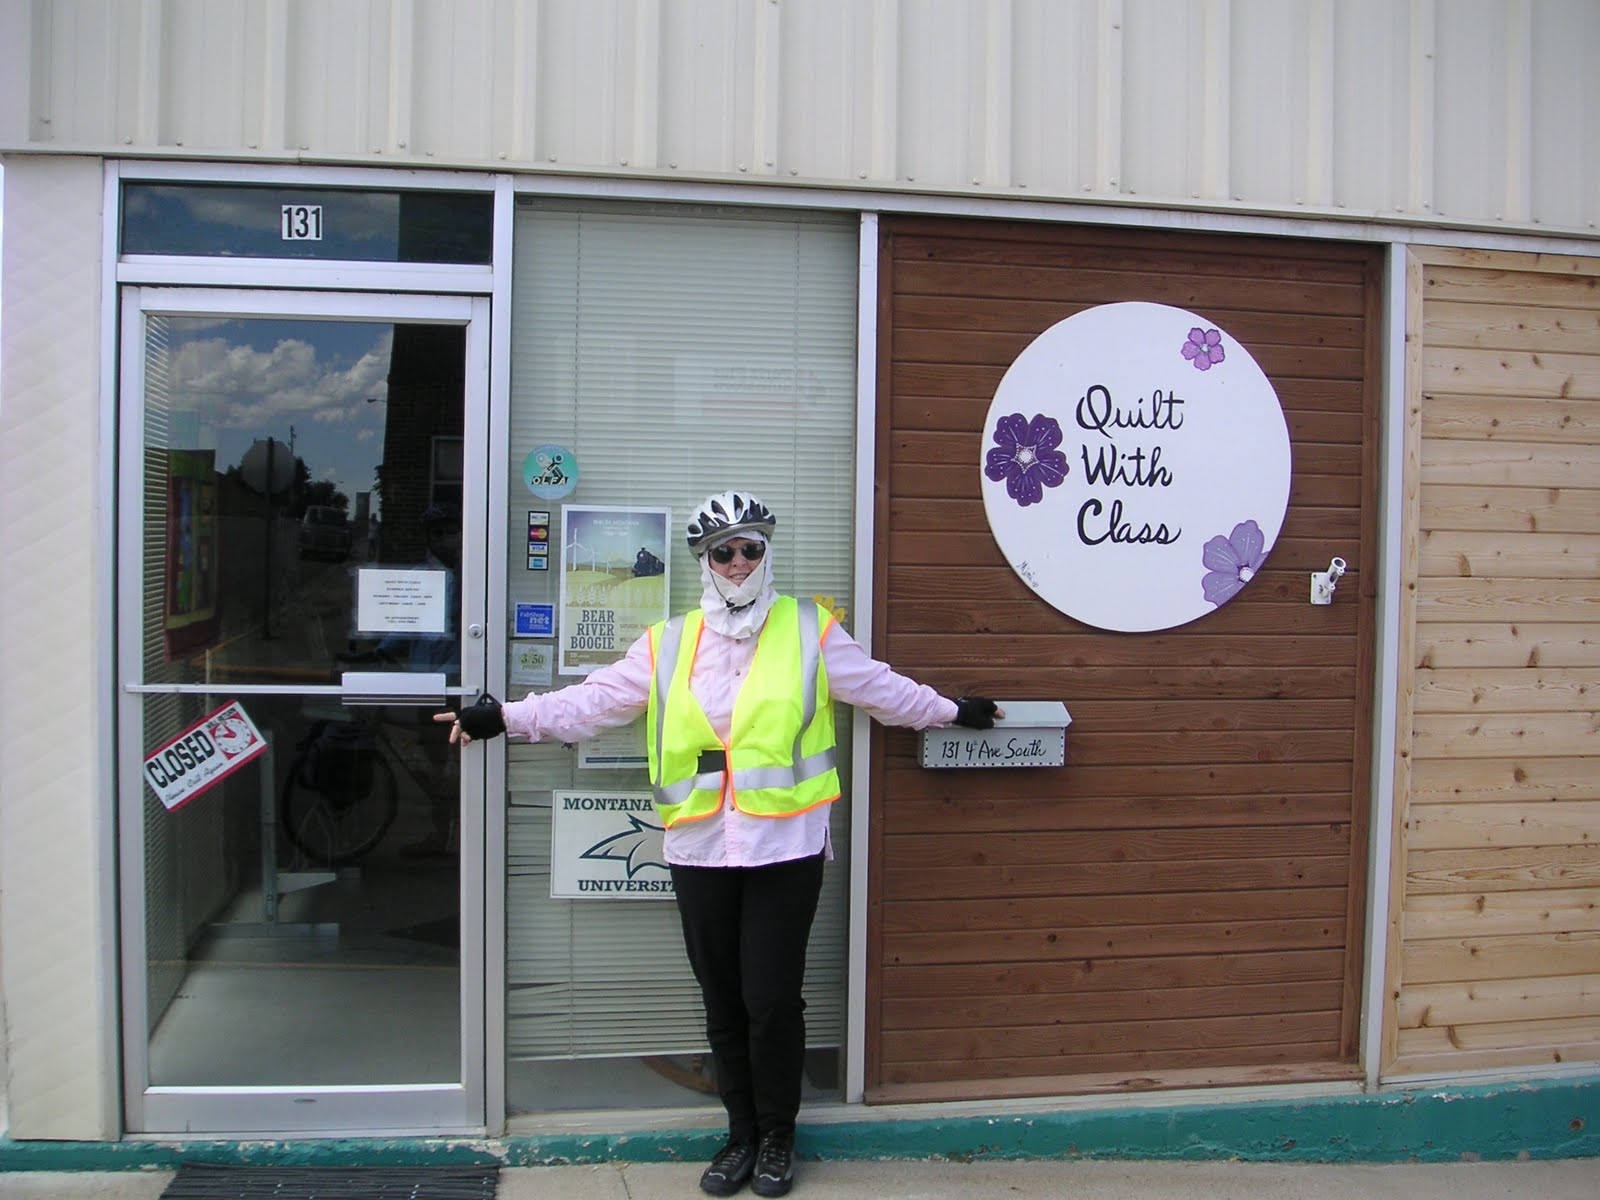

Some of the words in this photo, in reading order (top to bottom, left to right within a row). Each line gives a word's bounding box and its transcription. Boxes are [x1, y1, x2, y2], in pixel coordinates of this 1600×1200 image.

[283, 207, 320, 238] 131
[1076, 384, 1184, 439] Quilt
[1081, 443, 1173, 487] With
[531, 476, 568, 485] OLFA
[1076, 498, 1181, 545] Class
[582, 610, 615, 623] BEAR
[576, 623, 615, 636] RIVER
[570, 636, 615, 649] BOOGIE
[942, 741, 960, 759] 131
[1004, 738, 1046, 759] South
[146, 729, 216, 788] CLOSED
[563, 798, 653, 811] MONTANA
[578, 880, 674, 892] UNIVERSI
